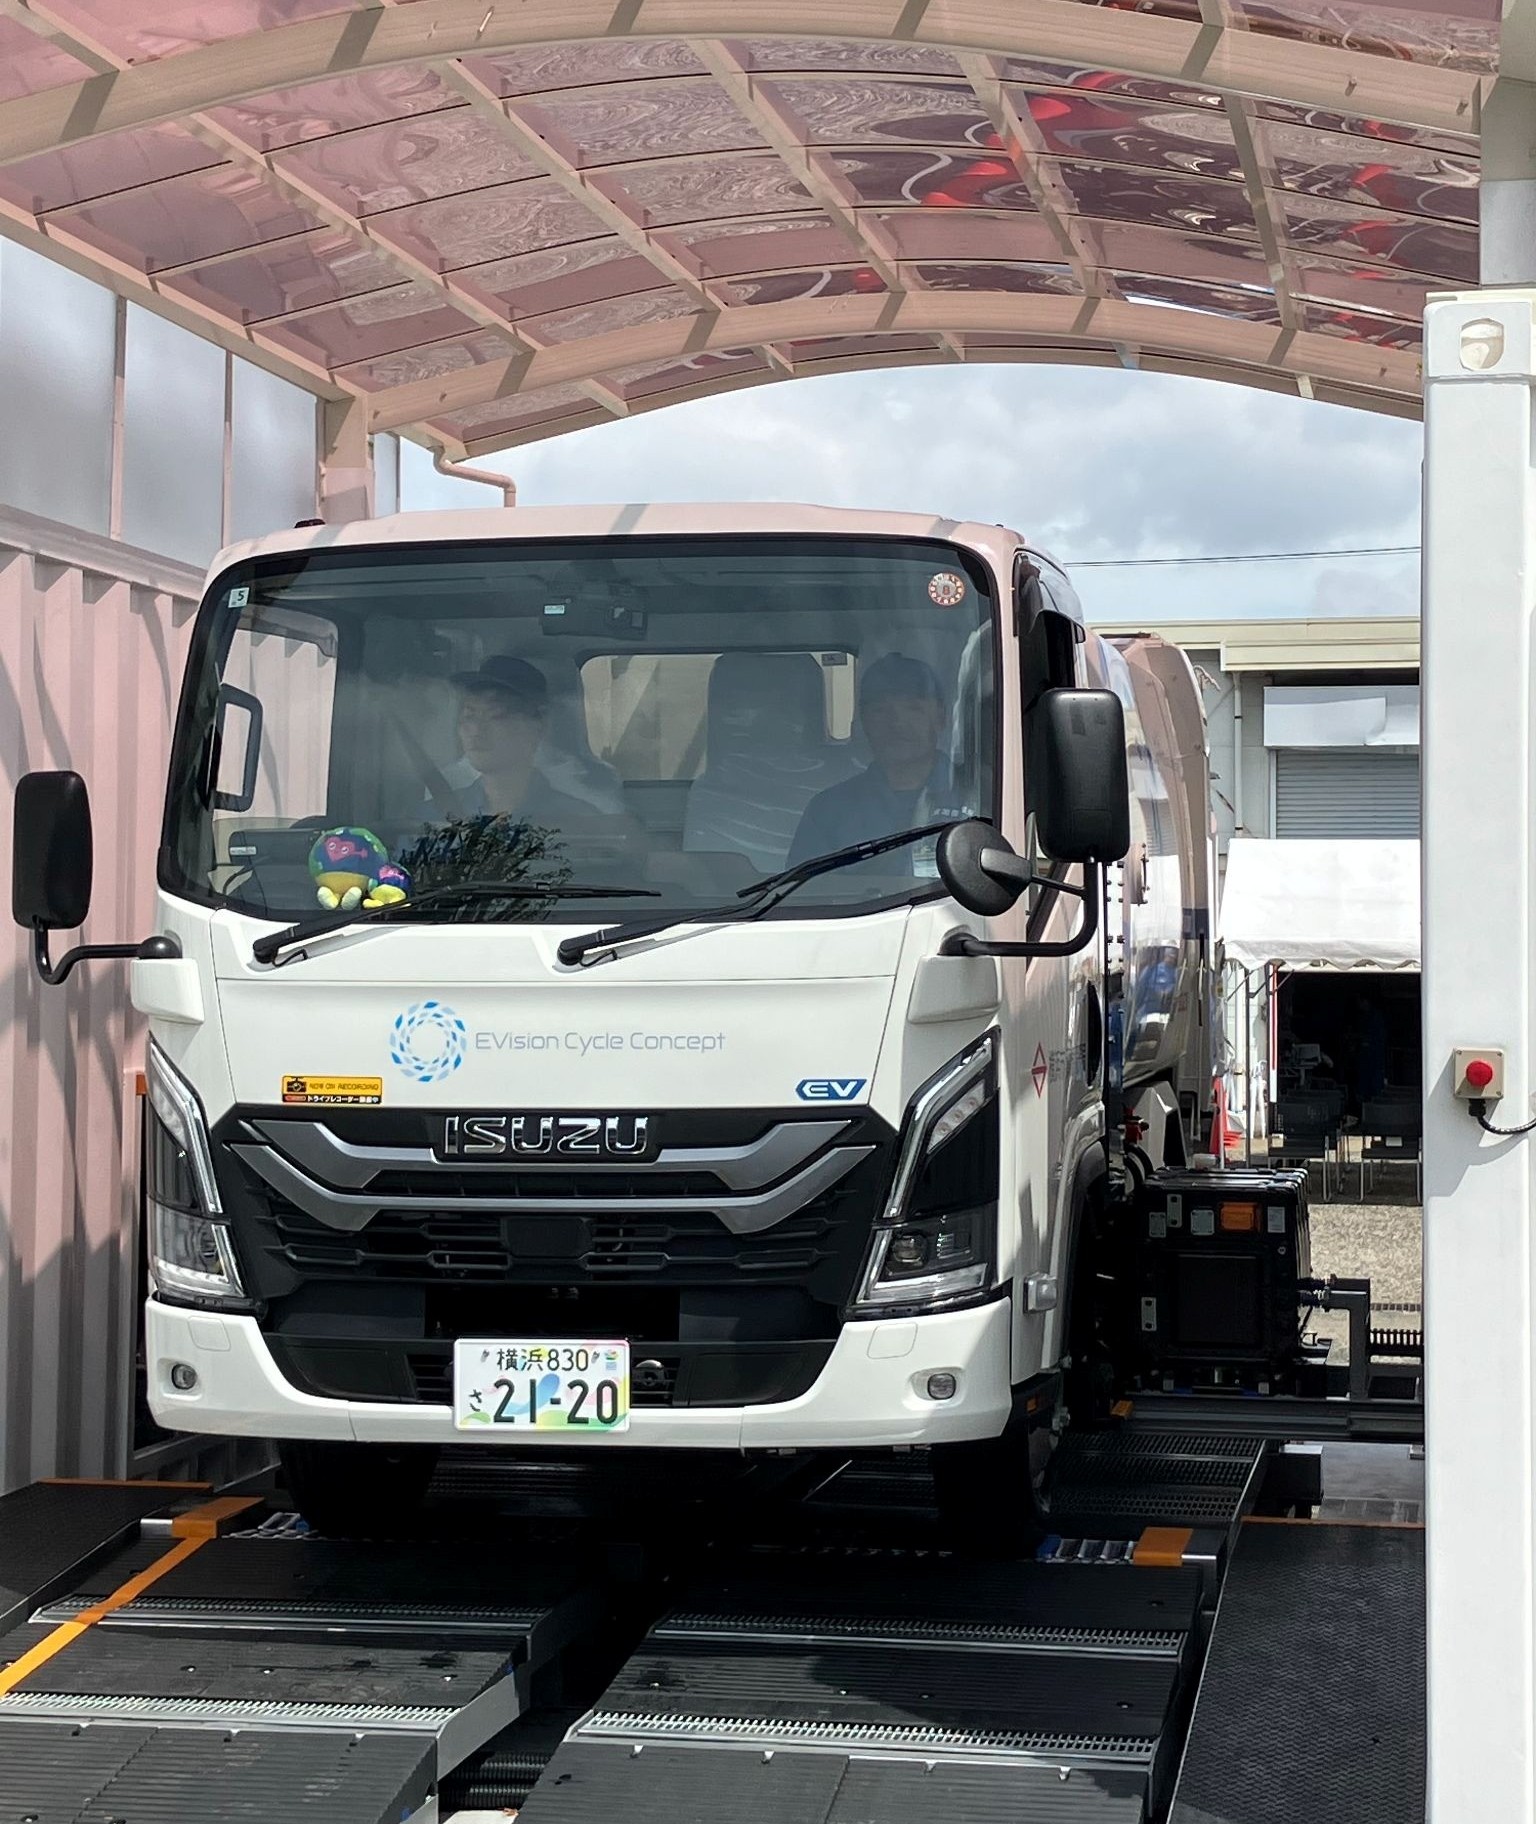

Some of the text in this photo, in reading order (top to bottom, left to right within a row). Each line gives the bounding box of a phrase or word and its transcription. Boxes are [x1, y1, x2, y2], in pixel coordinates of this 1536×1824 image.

[237, 591, 245, 601] 5
[475, 1032, 727, 1056] EVision Cycle Concept
[801, 1080, 858, 1098] EV
[444, 1115, 649, 1155] ISUZU
[469, 1378, 618, 1424] さ 21-20
